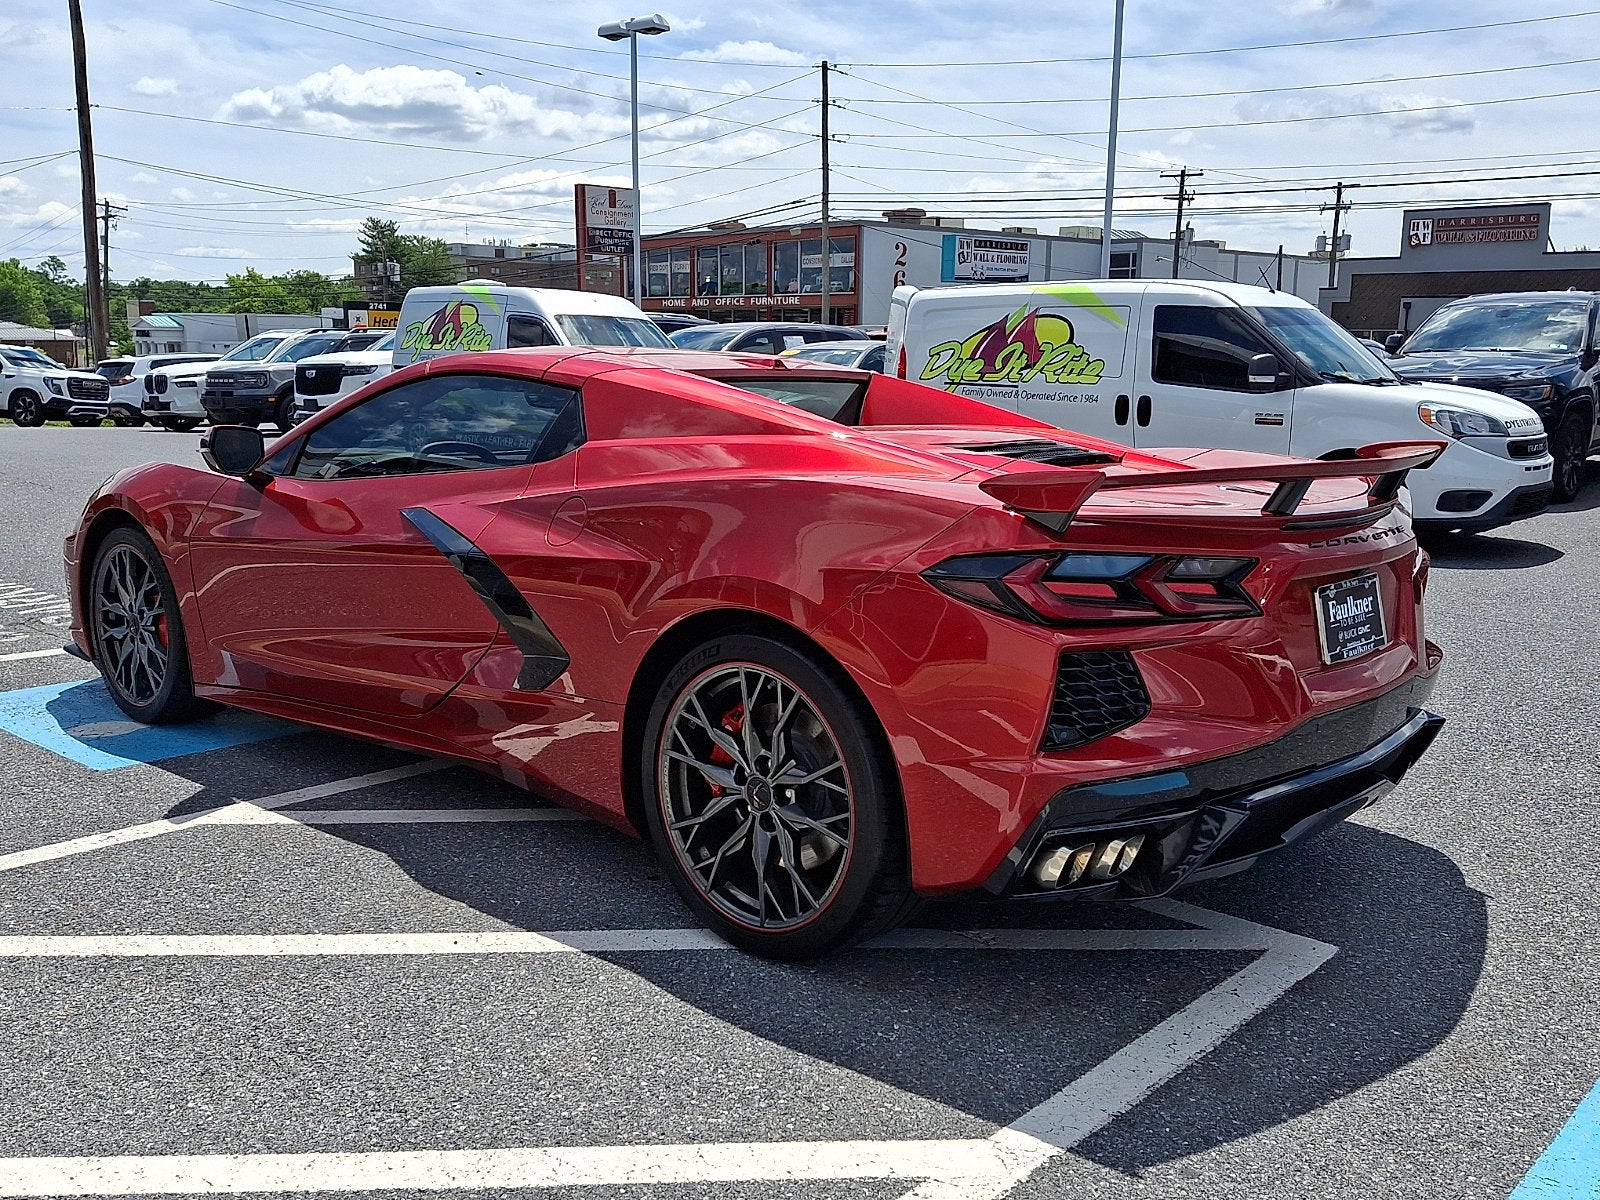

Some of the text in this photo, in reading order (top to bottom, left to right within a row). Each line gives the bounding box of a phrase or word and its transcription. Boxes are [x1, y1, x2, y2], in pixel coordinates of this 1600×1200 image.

[591, 206, 634, 218] Consignment
[604, 216, 627, 228] Gallery
[1439, 215, 1538, 226] HARRISBURG
[1435, 232, 1464, 243] WALL
[1476, 228, 1538, 241] FLOORING
[974, 240, 1028, 250] HARRISBURG
[973, 252, 989, 262] WALL
[997, 254, 1028, 265] FLOORING
[662, 296, 800, 307] HOME AND OFFICE FURNITURE
[401, 321, 433, 362] Dye
[919, 341, 985, 392] Dye
[1021, 342, 1106, 385] Rite
[961, 387, 1099, 403] Family Owned & Operated Since 1984
[1307, 525, 1406, 548] CORVETTE
[1328, 595, 1373, 622] Faulkner
[1340, 613, 1366, 627] TO BE SURE
[1344, 625, 1371, 639] BUICK GMC
[1343, 642, 1375, 659] Faulkner
